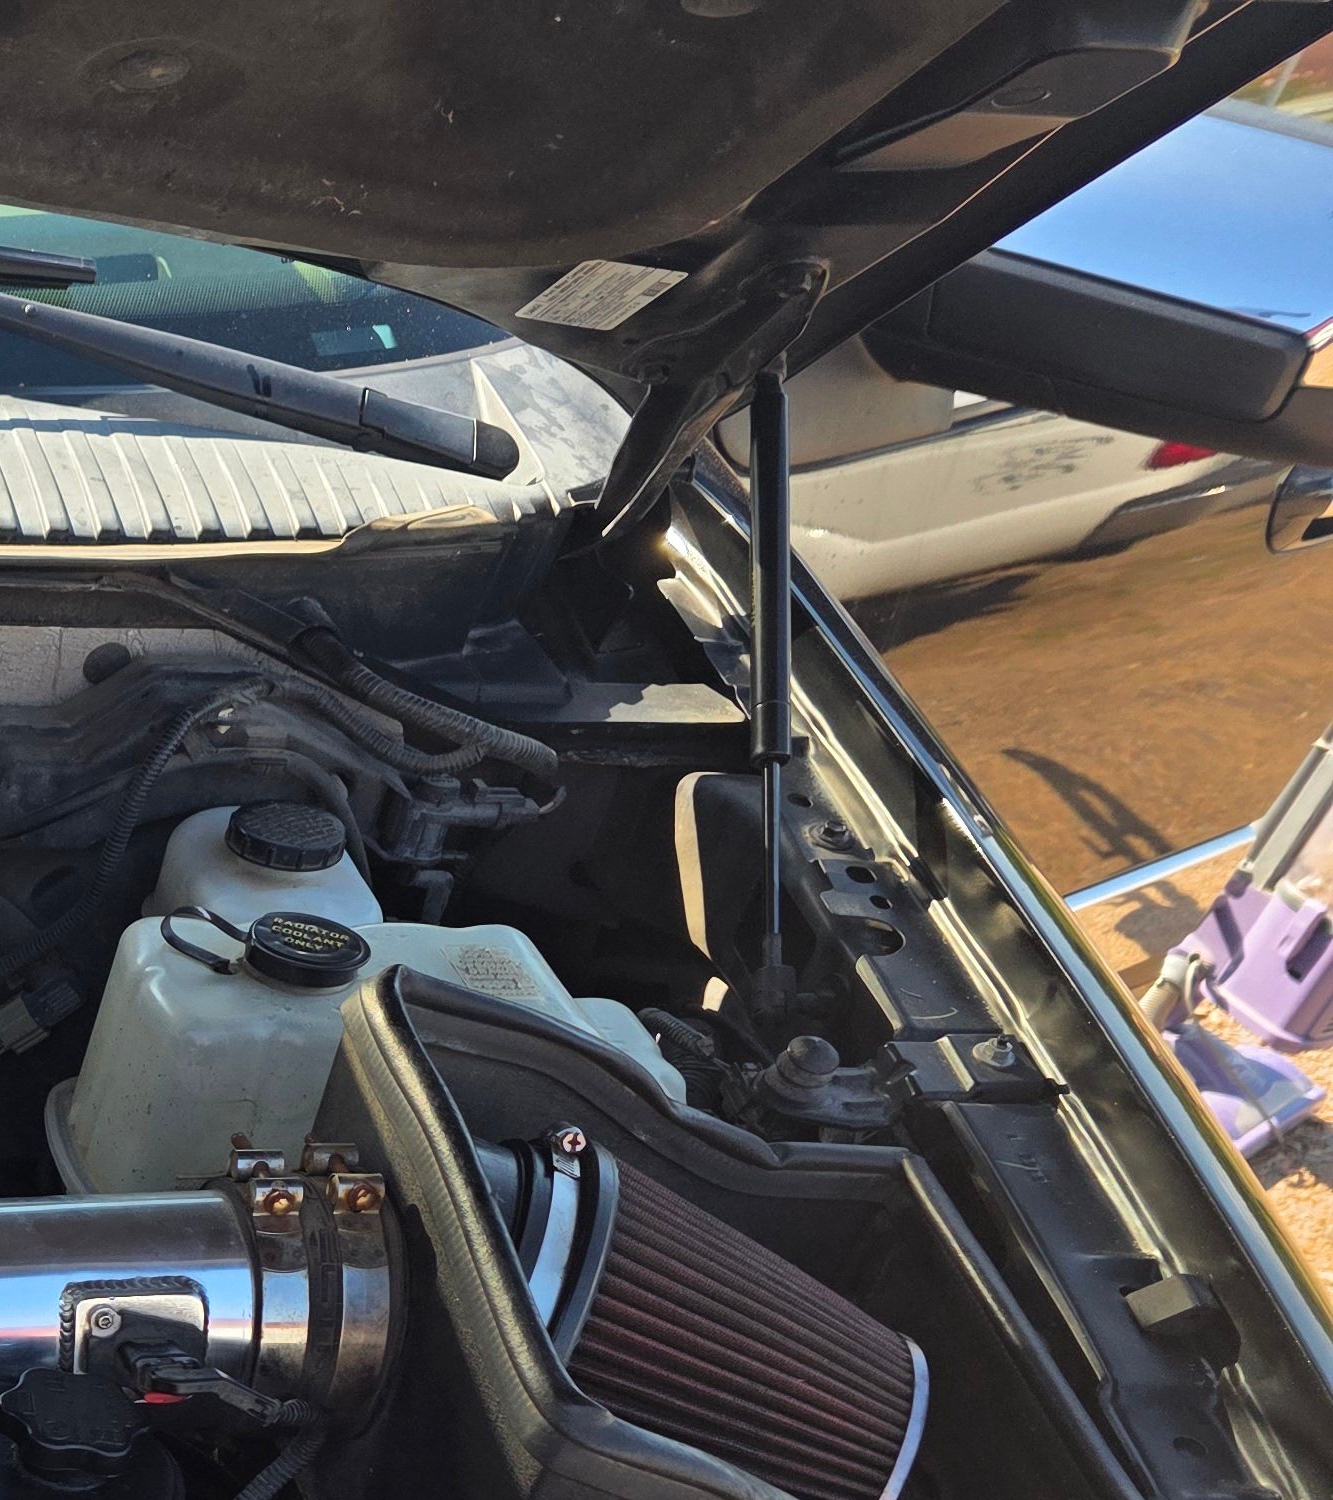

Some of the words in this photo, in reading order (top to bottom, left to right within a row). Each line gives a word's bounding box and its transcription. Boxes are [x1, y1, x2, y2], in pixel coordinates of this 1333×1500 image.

[271, 925, 344, 948] COOLANT
[273, 917, 349, 941] RADIATOR
[284, 937, 323, 951] ONLY
